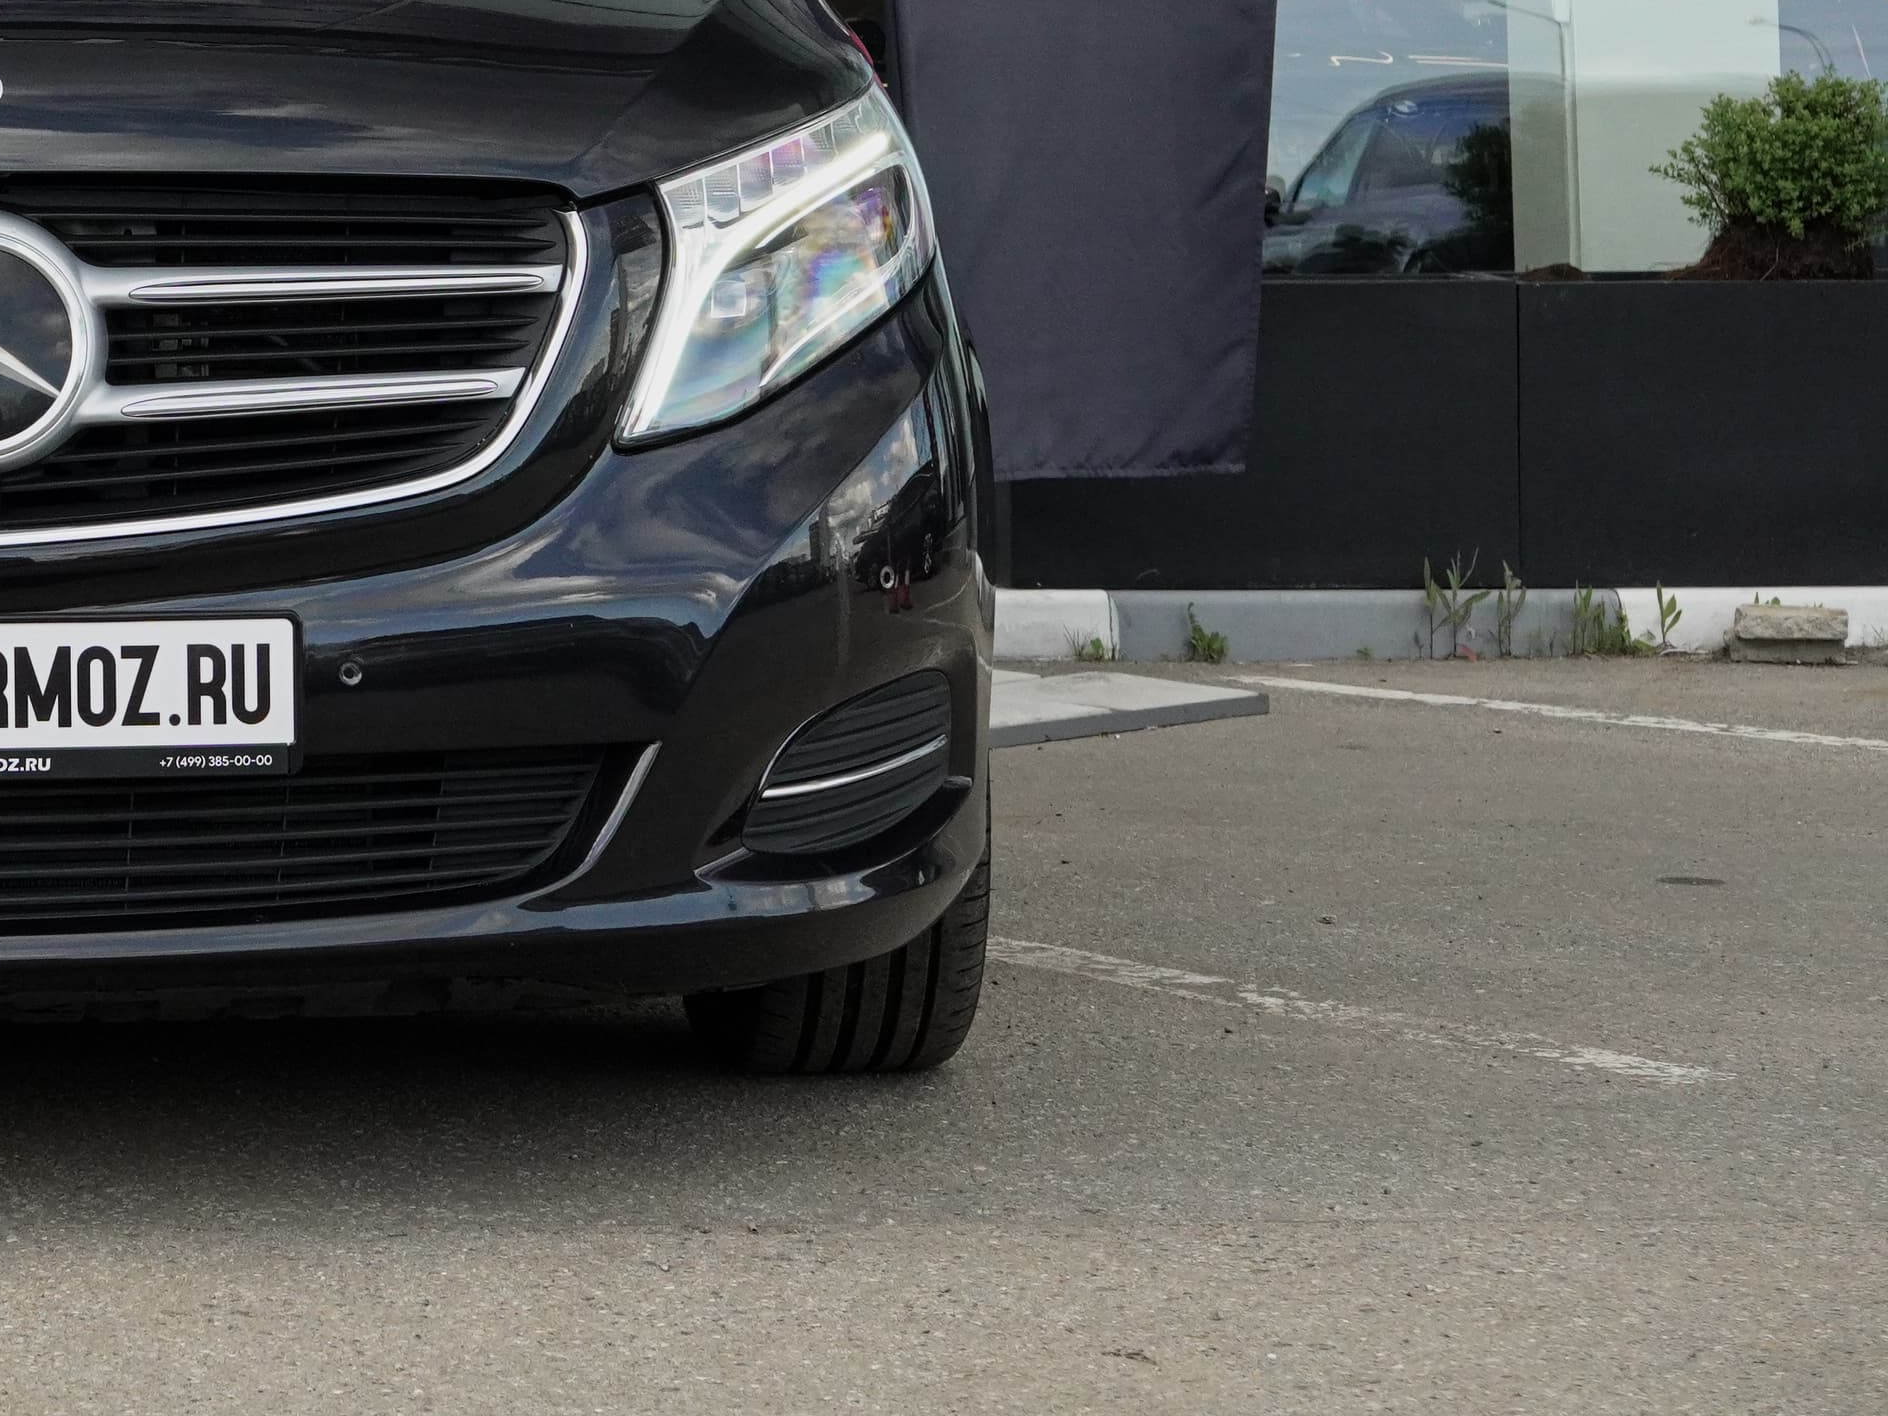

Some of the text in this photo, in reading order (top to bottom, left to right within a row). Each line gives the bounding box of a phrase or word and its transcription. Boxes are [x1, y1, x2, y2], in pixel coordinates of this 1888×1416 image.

[159, 754, 273, 769] +7 (499) 385-00-00
